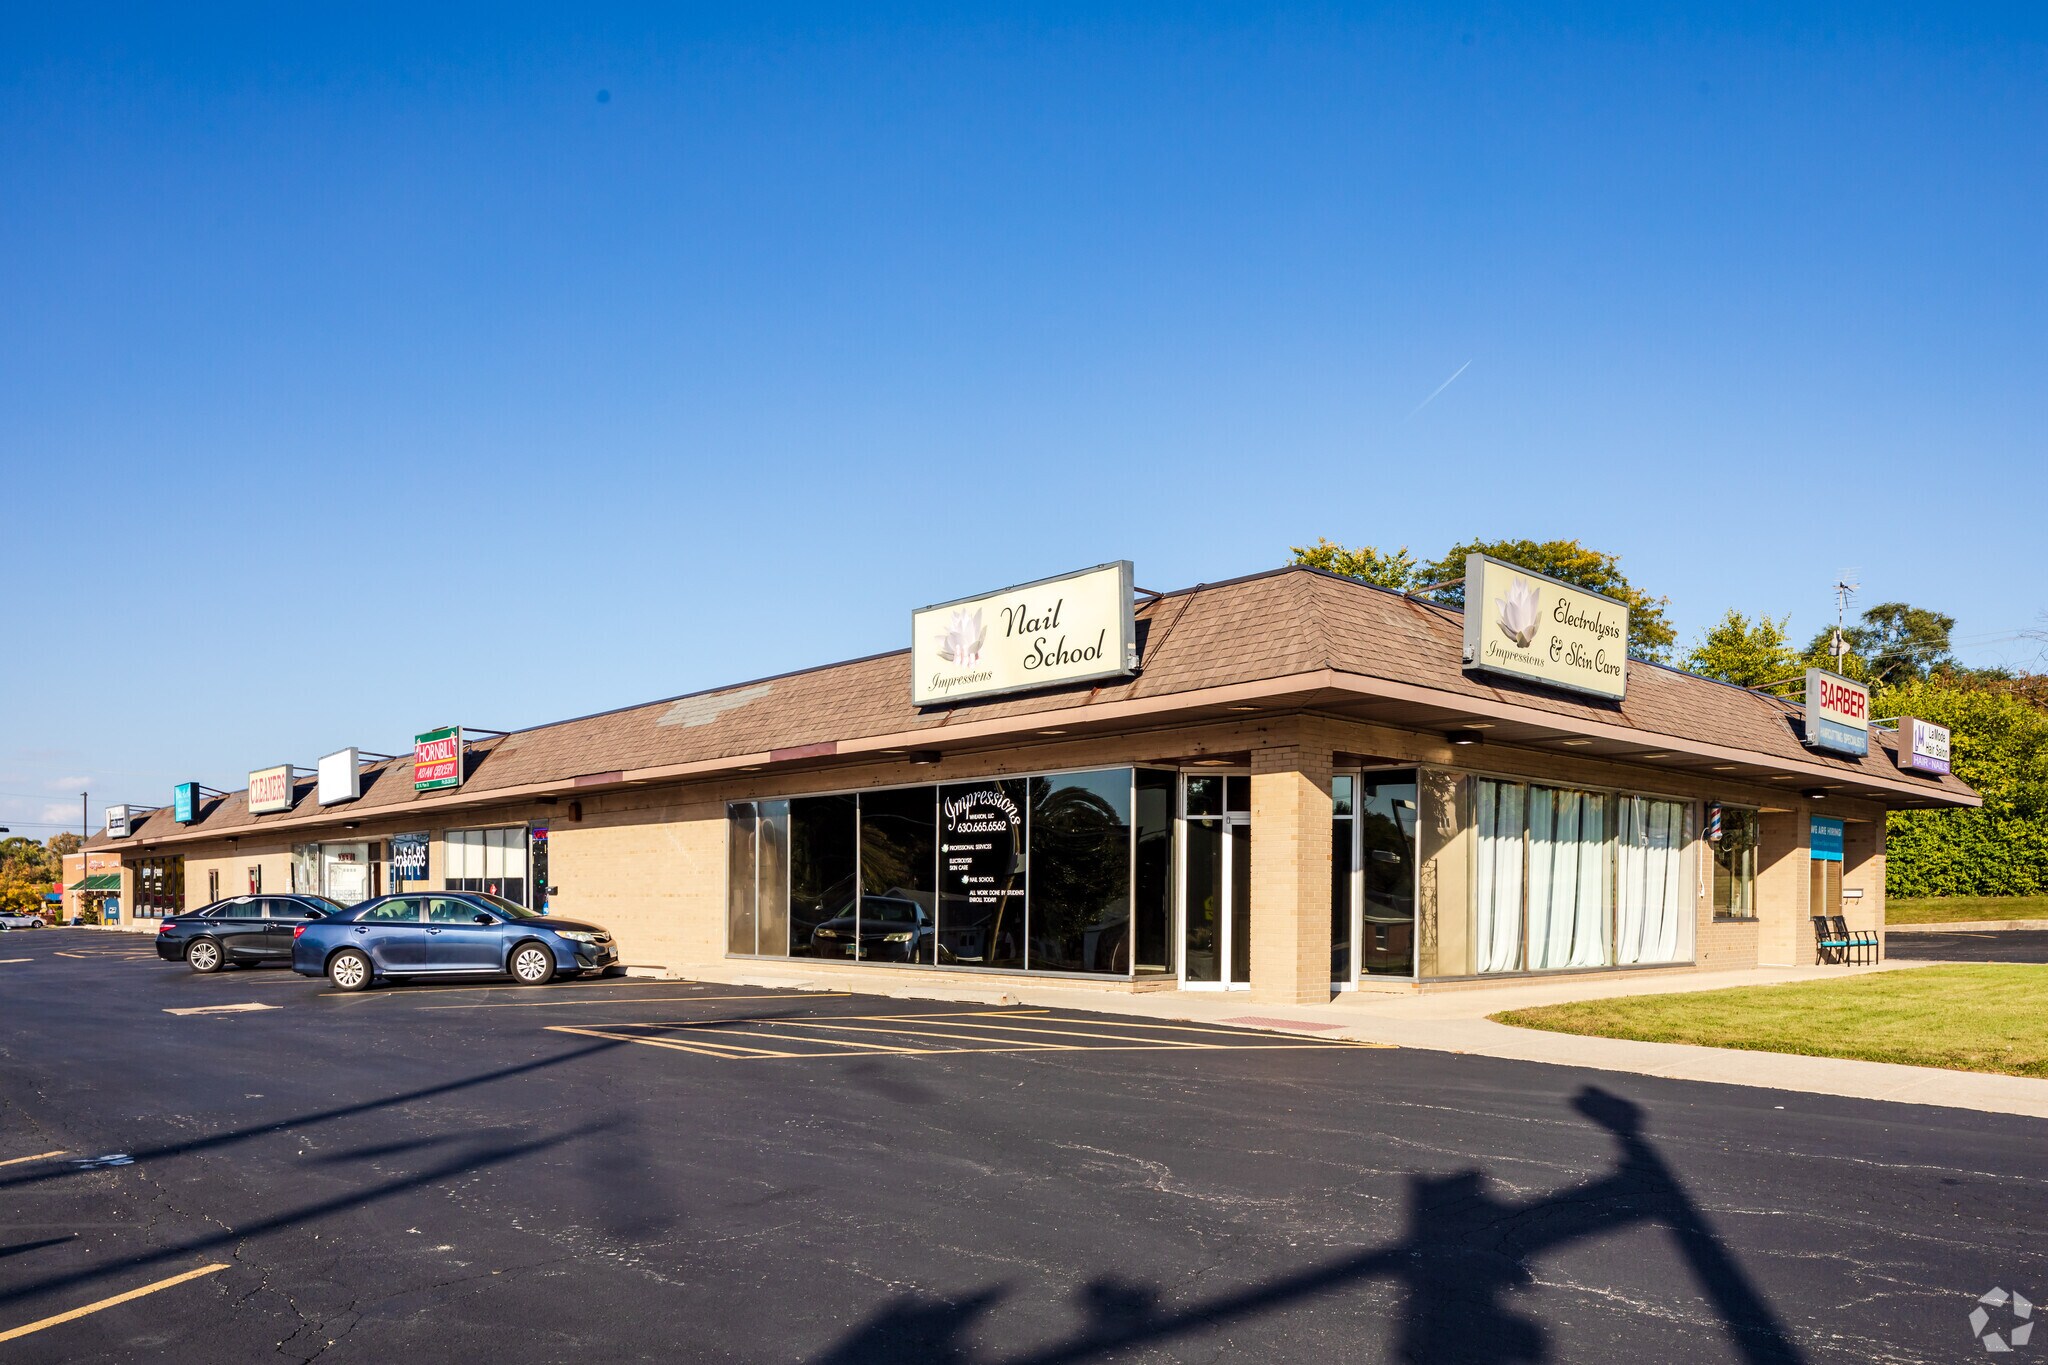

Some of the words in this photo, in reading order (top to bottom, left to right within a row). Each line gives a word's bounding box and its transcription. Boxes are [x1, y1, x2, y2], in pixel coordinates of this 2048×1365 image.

[1001, 598, 1063, 637] Nail
[1553, 597, 1620, 641] Electrolysis
[1023, 628, 1106, 670] School
[1485, 640, 1545, 668] Impressions
[1549, 635, 1564, 663] &
[1565, 641, 1593, 670] Skin
[1595, 648, 1621, 676] Care
[928, 670, 993, 694] Impressions
[1820, 679, 1865, 720] BARBER
[418, 740, 453, 762] HORNBILL
[1913, 756, 1929, 767] HAIR
[1931, 760, 1948, 772] NAILS
[417, 765, 434, 779] ASIAN
[250, 773, 286, 804] CLEANERS
[944, 790, 1021, 832] Impressions
[957, 820, 1007, 833] 630.665.6562
[1818, 825, 1827, 835] ARE
